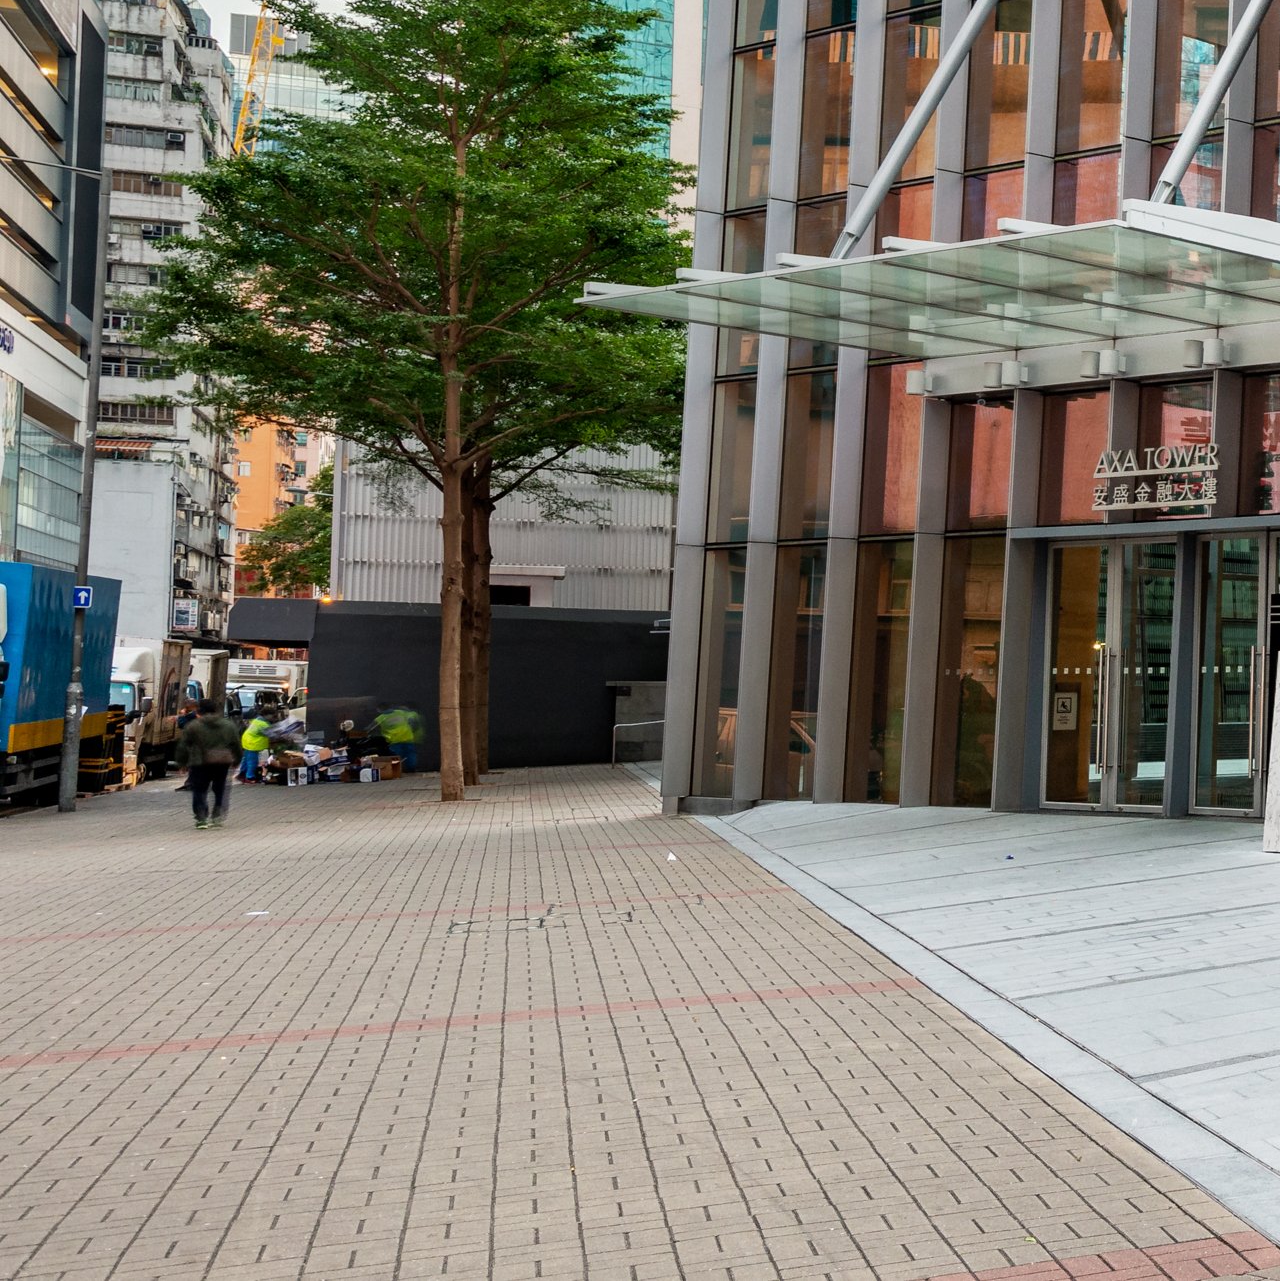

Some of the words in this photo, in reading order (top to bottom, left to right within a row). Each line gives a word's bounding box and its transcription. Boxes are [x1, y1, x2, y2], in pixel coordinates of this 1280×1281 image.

[1095, 448, 1139, 475] AXA
[1143, 443, 1219, 471] TOWER
[1093, 477, 1218, 506] 安盛金融大樓
